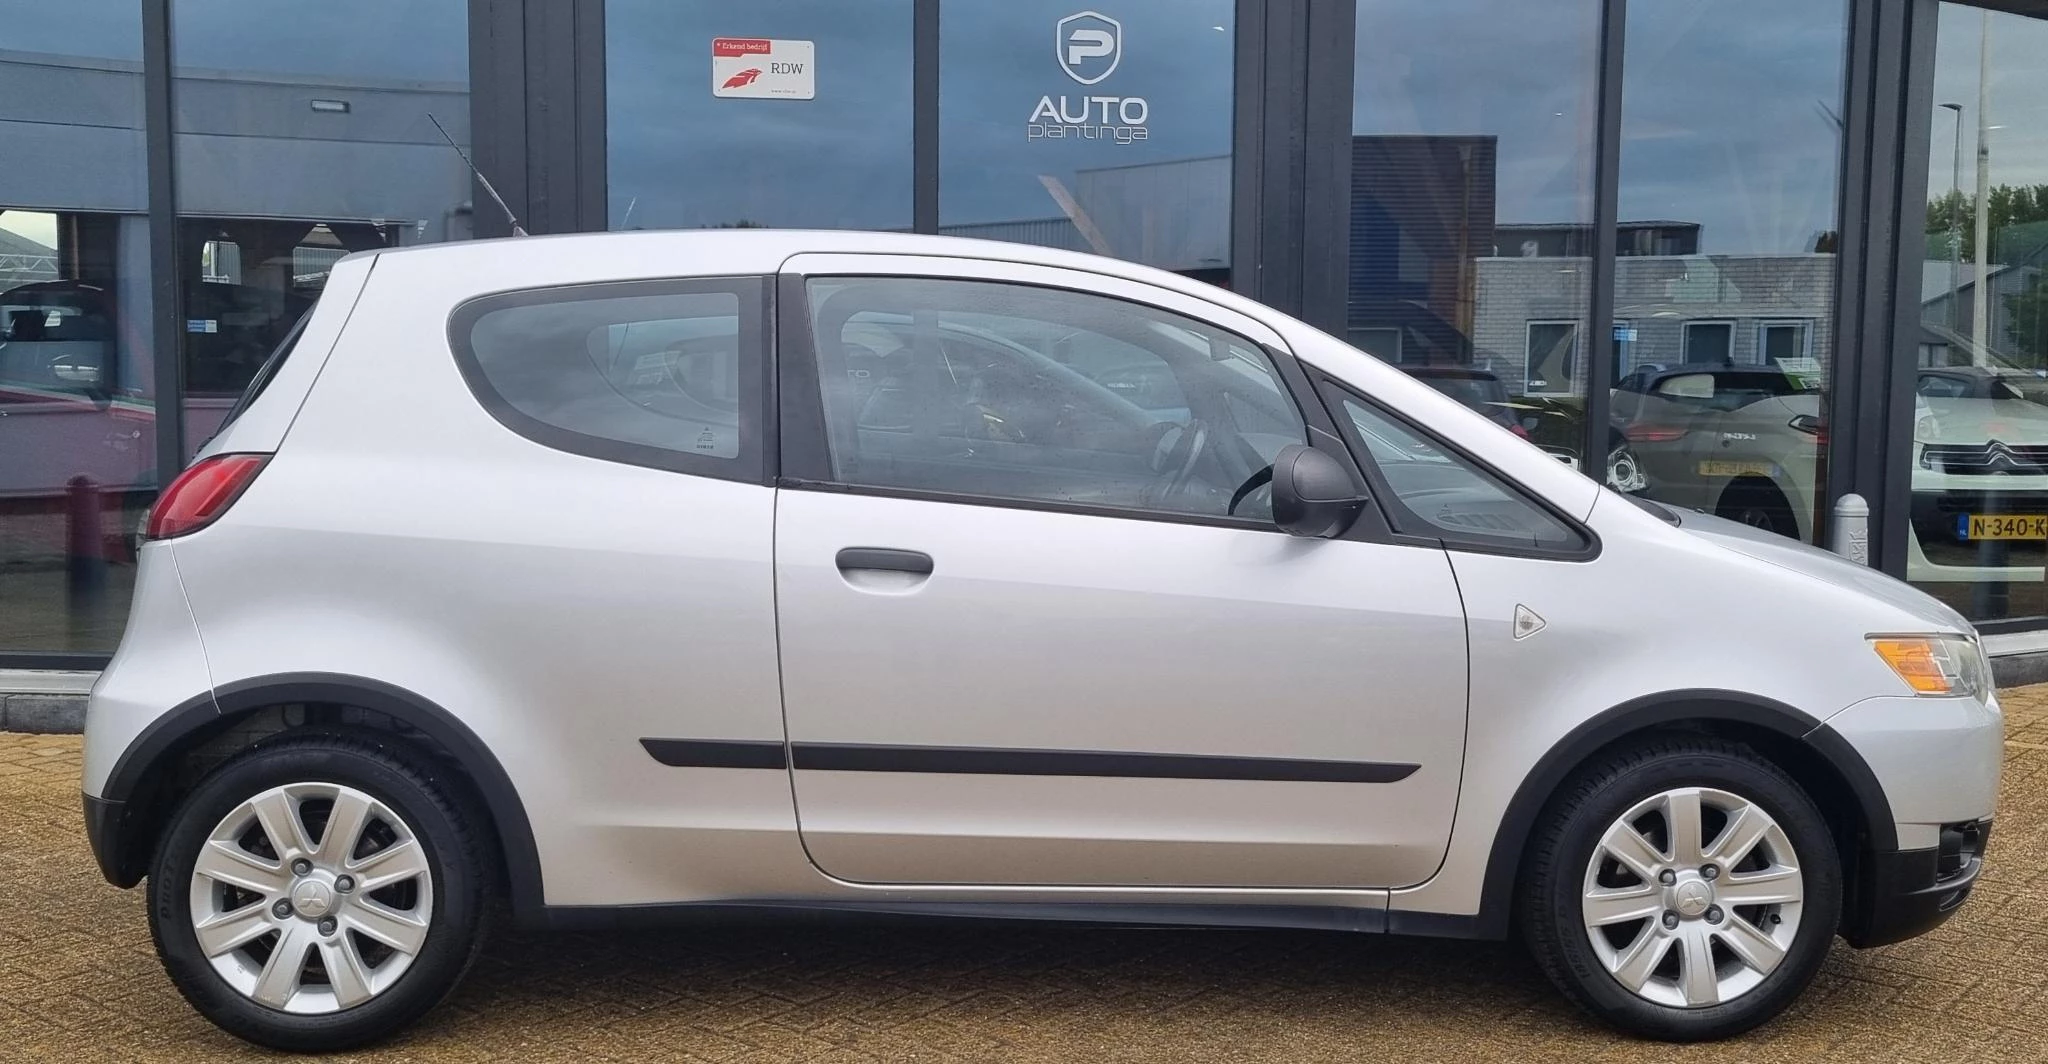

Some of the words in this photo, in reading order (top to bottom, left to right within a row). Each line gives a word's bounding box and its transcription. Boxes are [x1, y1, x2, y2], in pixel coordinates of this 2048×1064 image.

[746, 43, 768, 52] bedrijf
[1068, 29, 1114, 65] P
[771, 62, 804, 75] RDW
[1028, 95, 1149, 125] AUTO
[1027, 121, 1149, 145] plantinga
